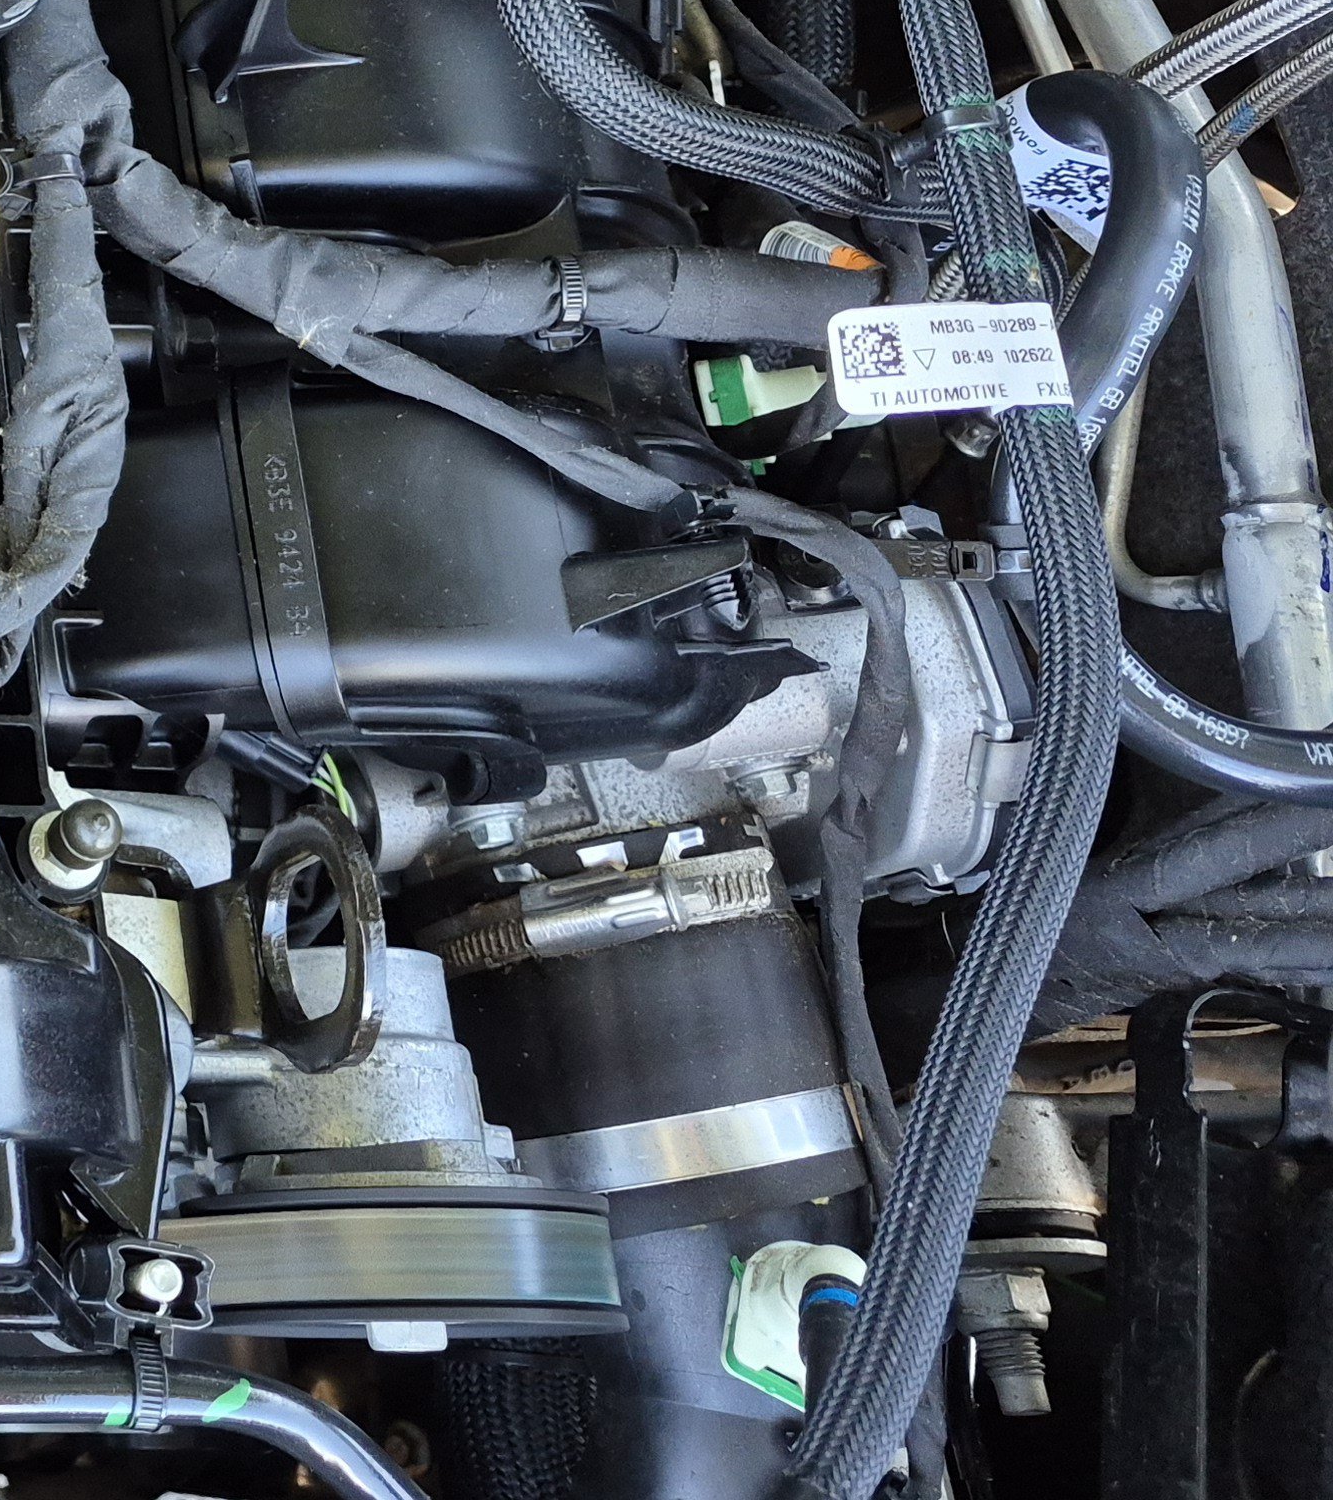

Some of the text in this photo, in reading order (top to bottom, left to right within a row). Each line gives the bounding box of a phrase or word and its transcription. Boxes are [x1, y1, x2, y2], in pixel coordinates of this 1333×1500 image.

[1004, 95, 1048, 156] FoMoCo
[1156, 239, 1193, 302] BRAKE
[930, 316, 1055, 336] MB3G-9D289-
[1115, 303, 1164, 377] ARNITEL
[952, 347, 1056, 365] 08:49 102622
[870, 391, 887, 407] TI
[894, 382, 1009, 406] AUTOMOTIVE
[274, 528, 305, 587] 9424
